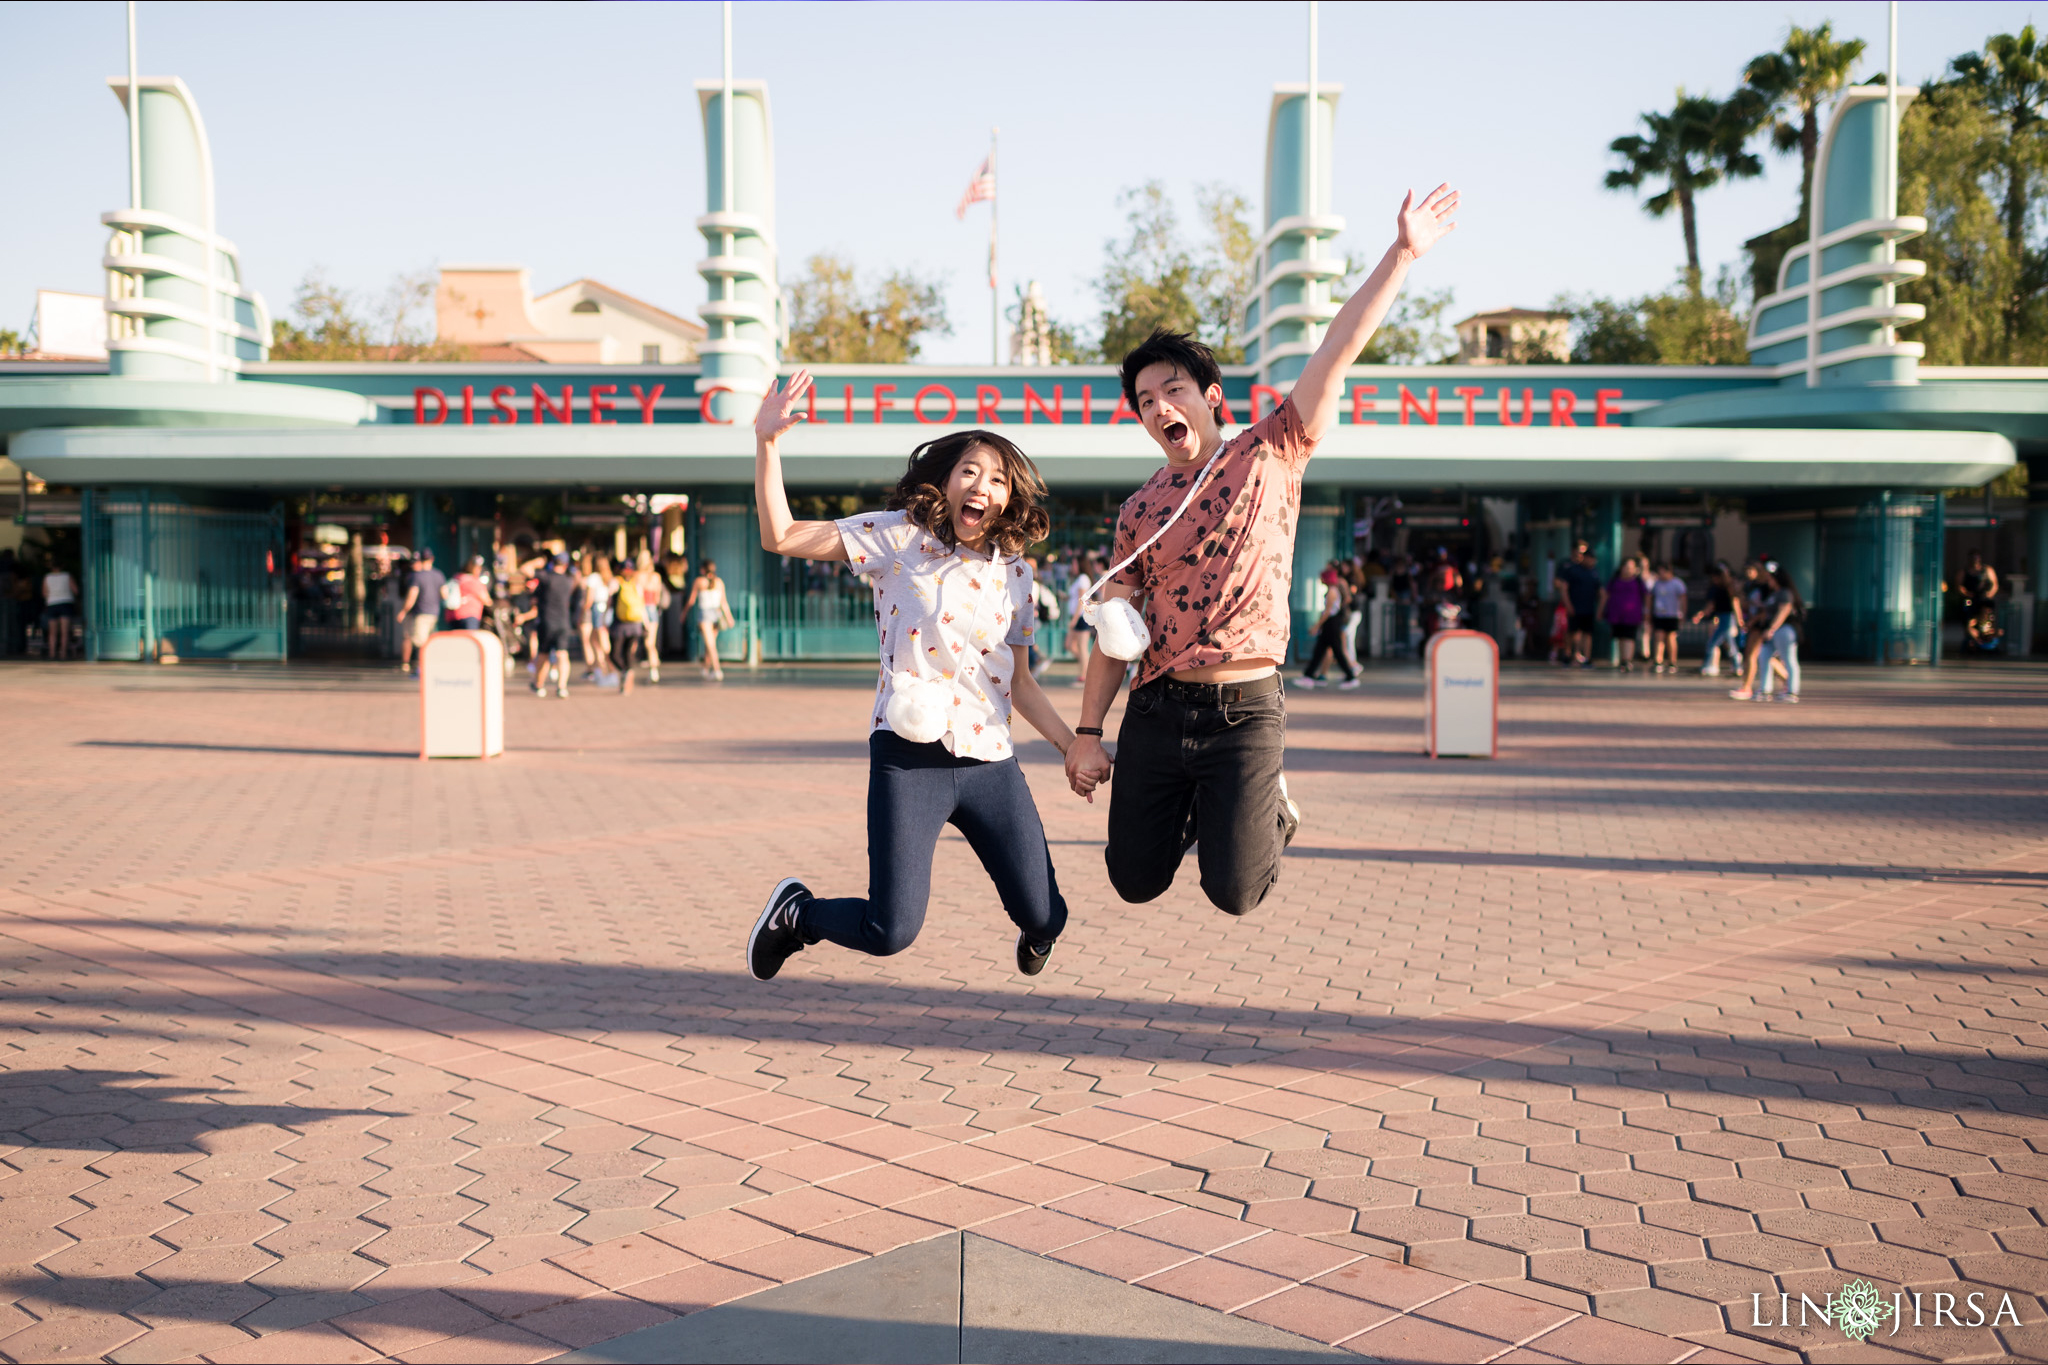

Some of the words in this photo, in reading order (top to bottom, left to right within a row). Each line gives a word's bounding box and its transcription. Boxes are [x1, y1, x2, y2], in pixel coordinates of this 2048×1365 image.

[413, 382, 666, 425] DISNEY
[700, 384, 1143, 425] CLIFORNIA
[1220, 383, 1625, 428] DENTURE
